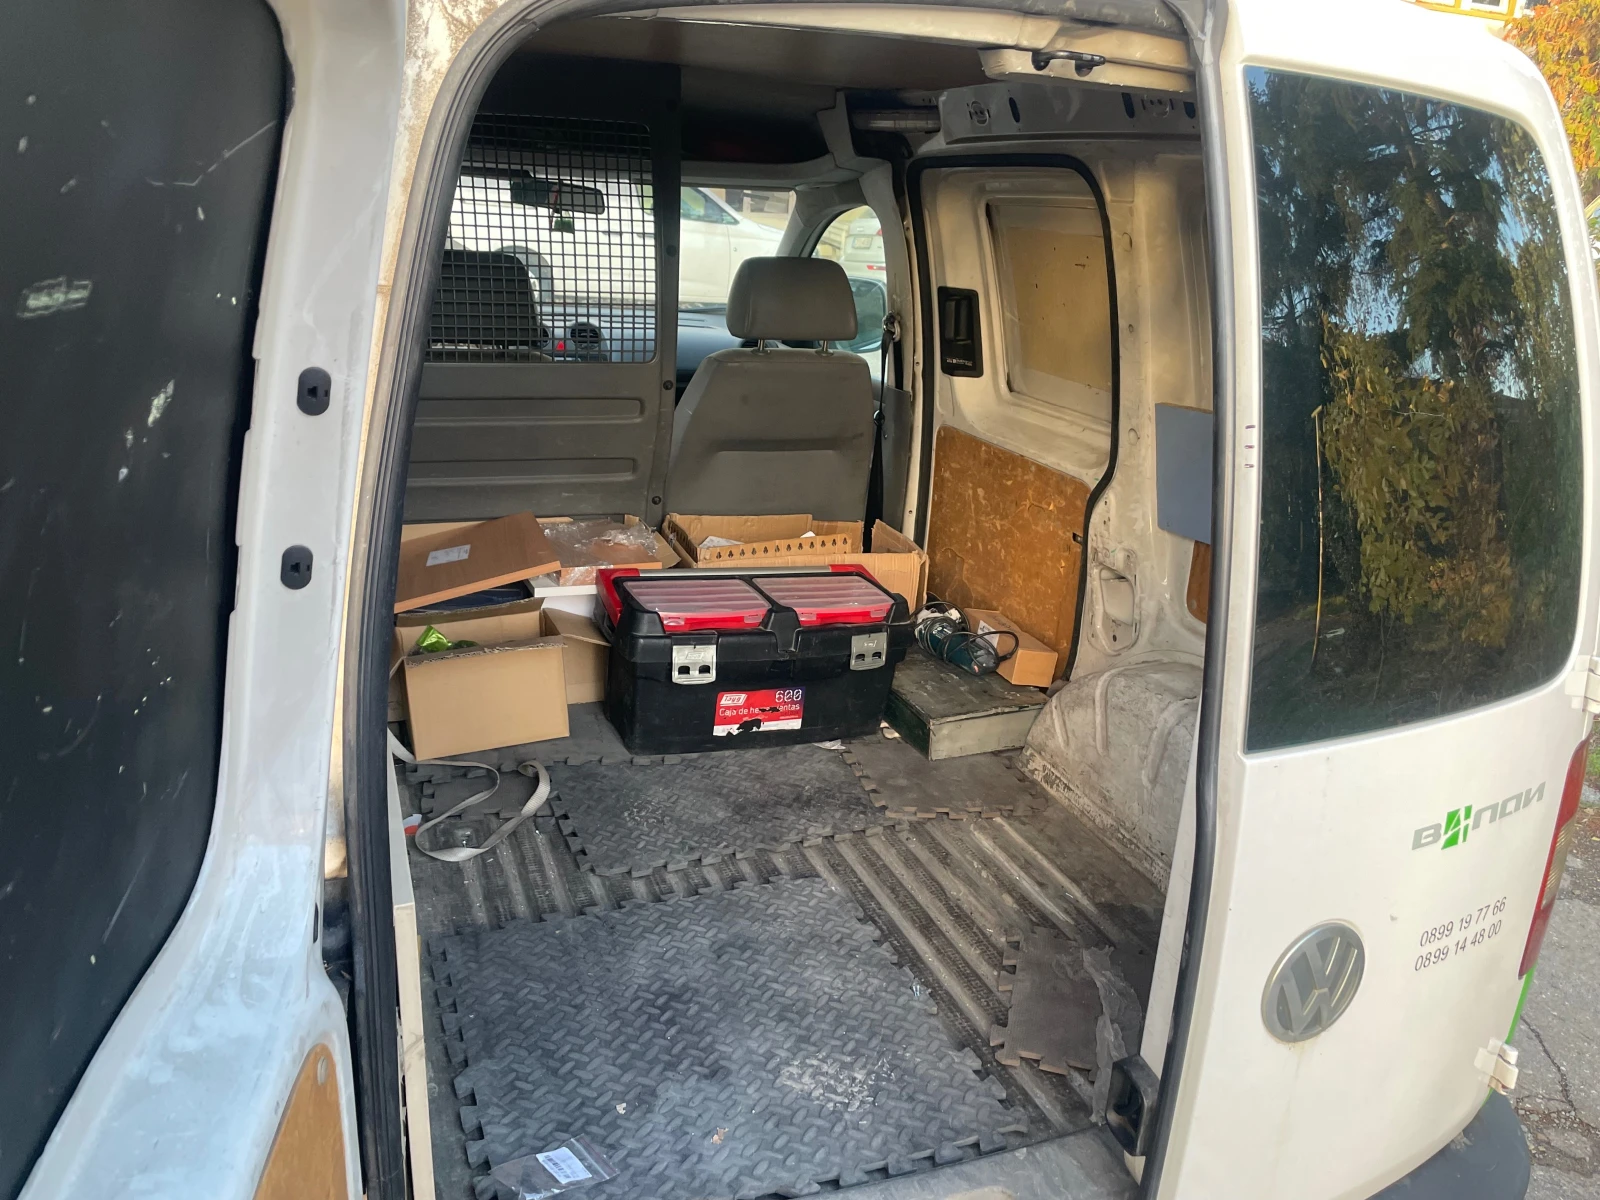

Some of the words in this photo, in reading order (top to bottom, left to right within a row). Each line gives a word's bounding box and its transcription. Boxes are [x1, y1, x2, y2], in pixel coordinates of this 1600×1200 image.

[719, 707, 737, 717] Caja
[738, 706, 749, 715] de
[750, 704, 800, 713] heentas
[775, 689, 802, 702] 600
[1420, 920, 1454, 947] 0899
[1459, 913, 1473, 931] 19
[1475, 904, 1491, 924] 77
[1492, 896, 1507, 916] 66
[1414, 944, 1450, 971] 0899
[1454, 936, 1468, 955] 14
[1470, 928, 1486, 947] 48
[1487, 919, 1502, 938] 00
